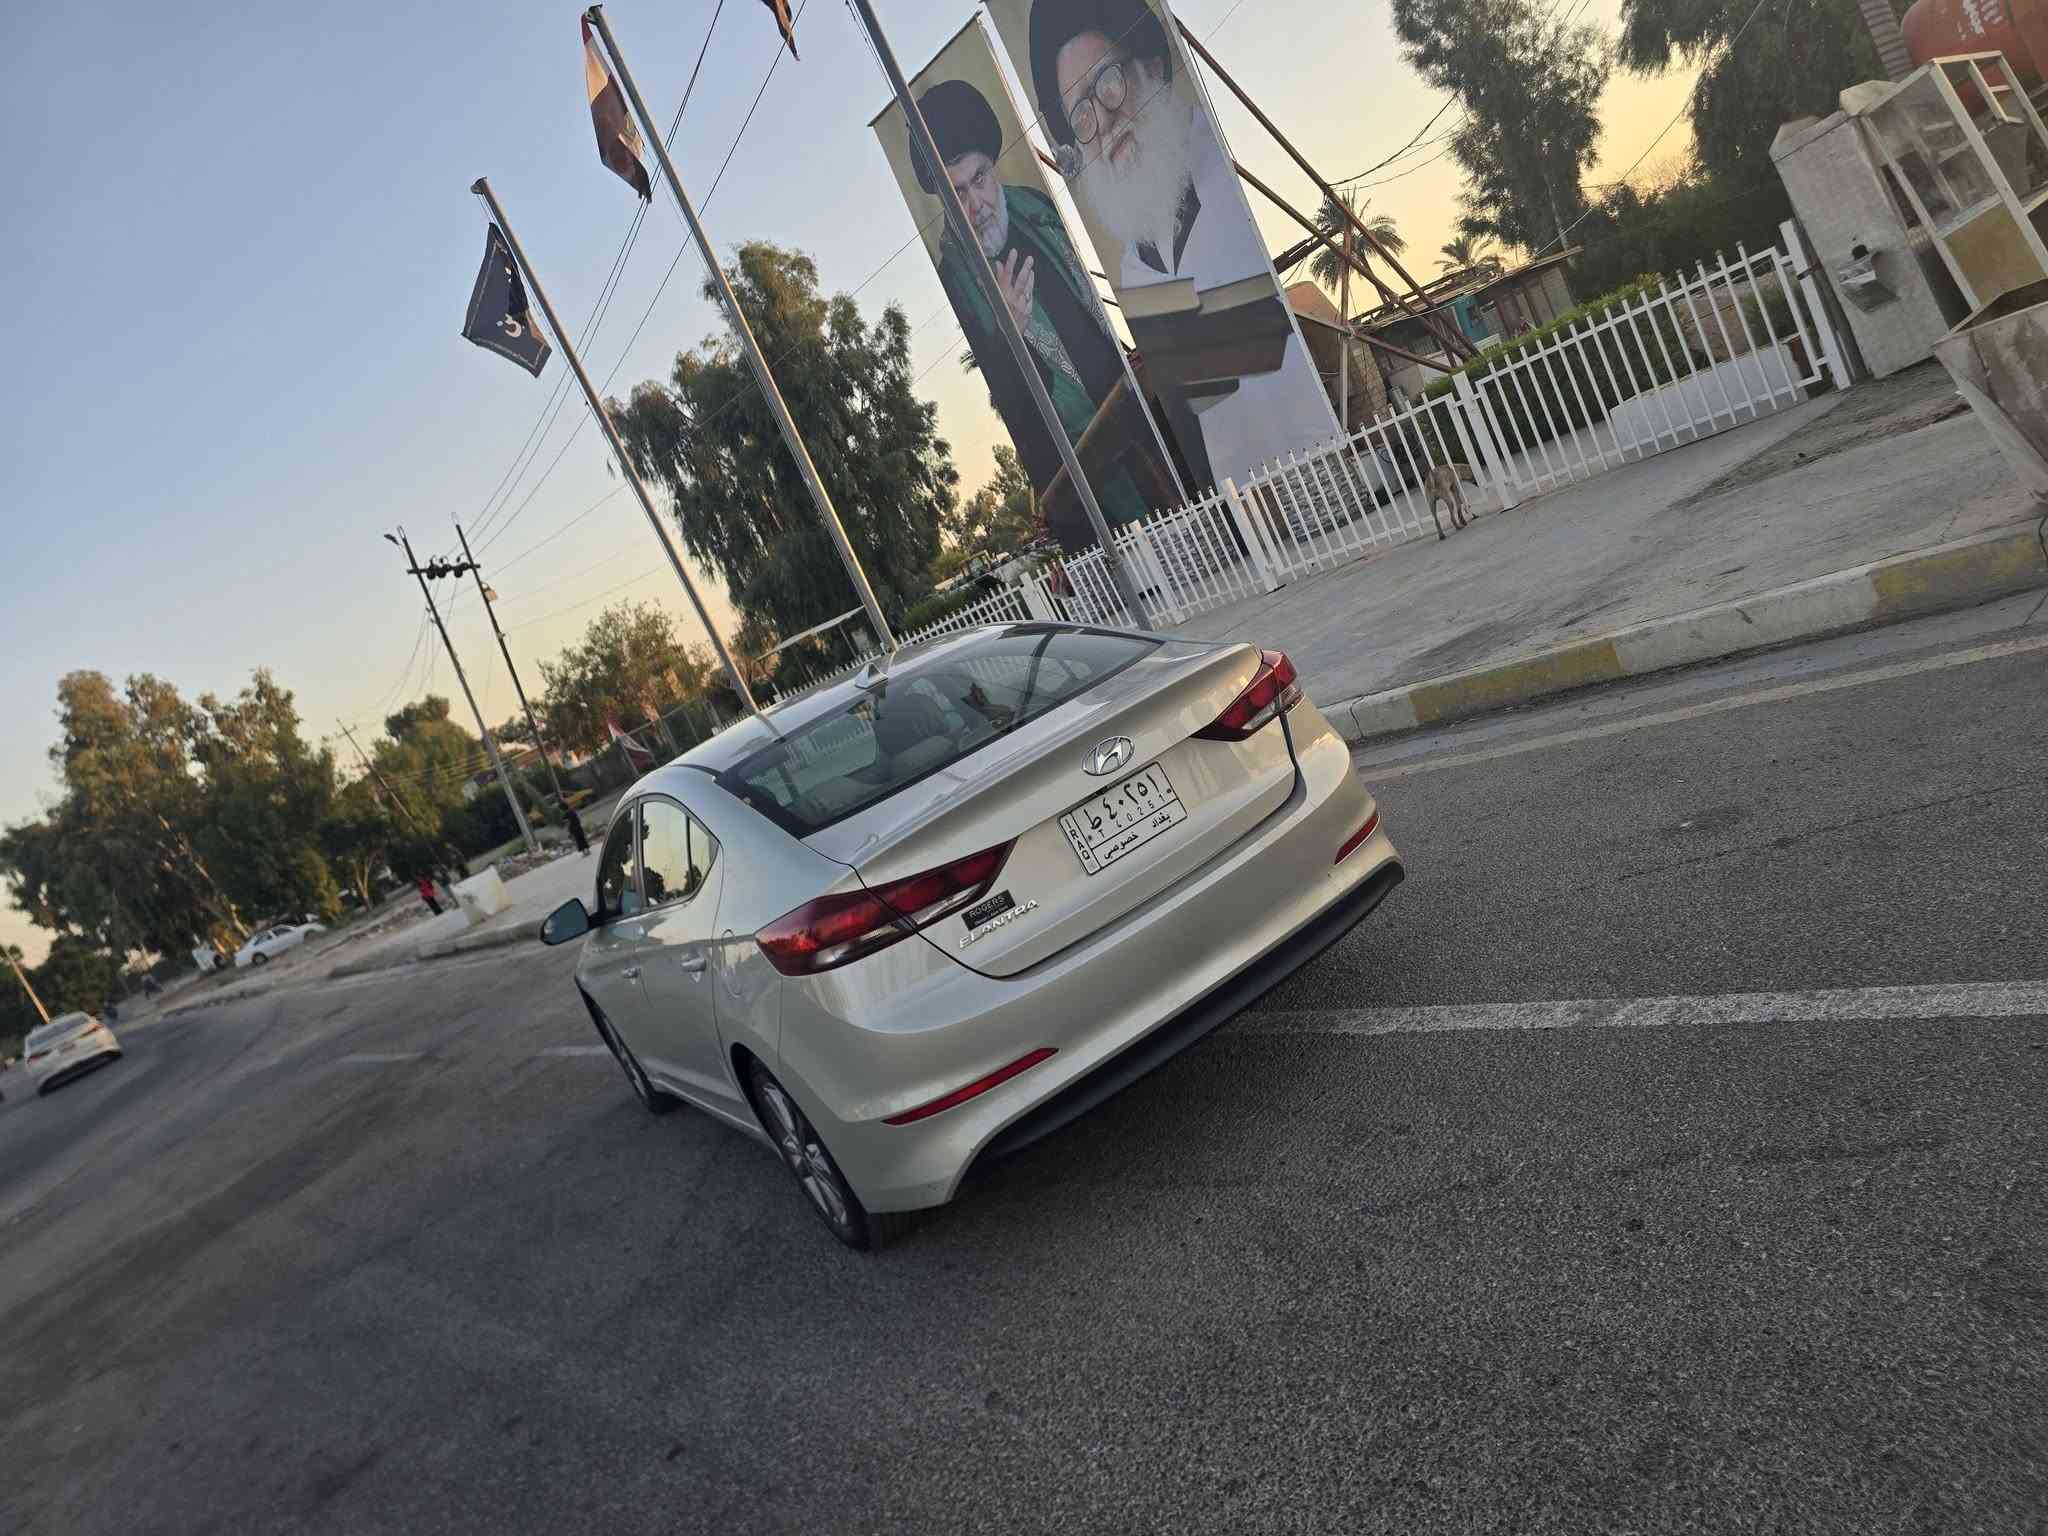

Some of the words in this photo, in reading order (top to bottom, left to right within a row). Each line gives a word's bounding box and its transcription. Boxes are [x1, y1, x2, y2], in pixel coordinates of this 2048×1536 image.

[1103, 773, 1160, 820] ٤٠٢٥١
[1063, 818, 1091, 861] IRAQ
[1151, 810, 1172, 829] بغداد
[1103, 831, 1139, 860] خصوصي
[959, 899, 1040, 949] ELANTRA
